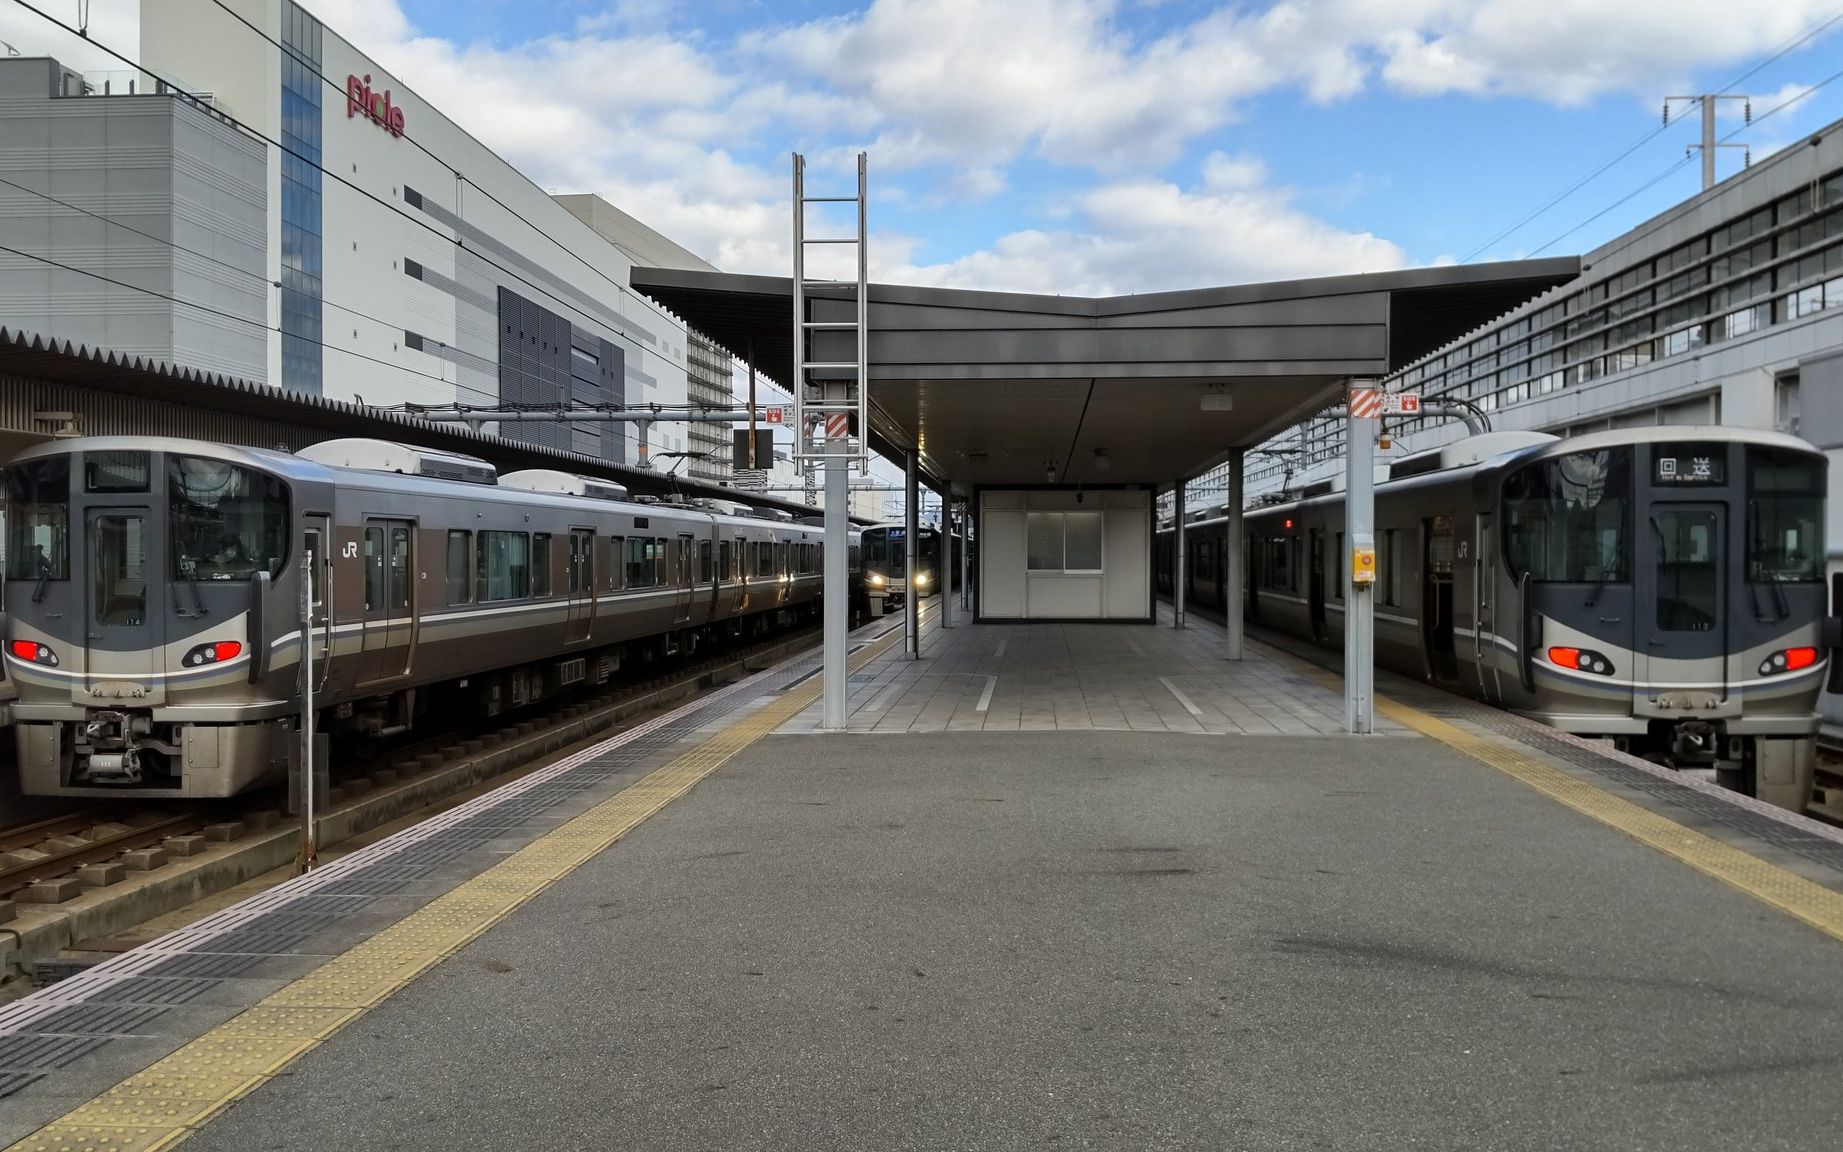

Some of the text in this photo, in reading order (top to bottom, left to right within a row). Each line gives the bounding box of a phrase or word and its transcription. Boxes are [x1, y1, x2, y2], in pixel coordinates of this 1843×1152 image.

[347, 74, 405, 139] piole
[1660, 457, 1710, 475] 回送
[343, 541, 357, 558] JR
[1457, 541, 1468, 558] JR
